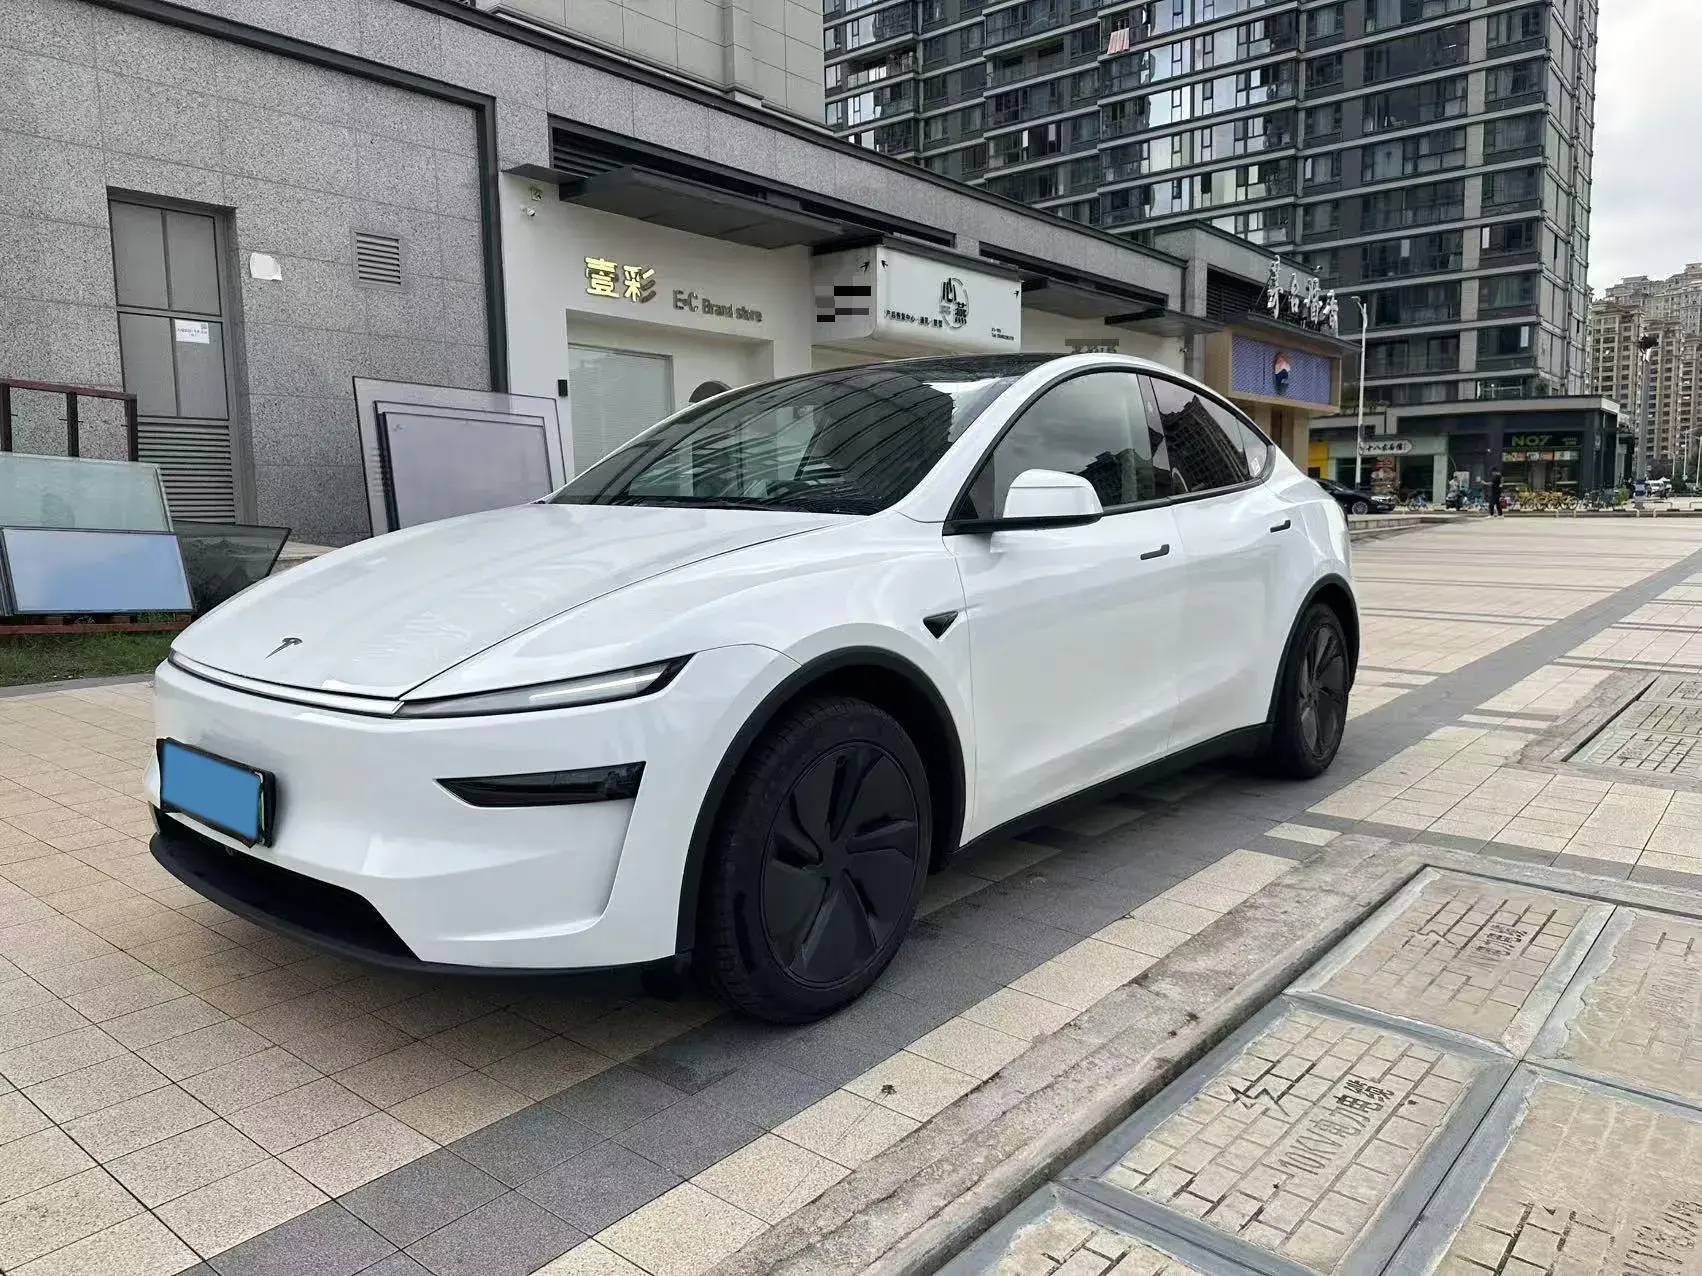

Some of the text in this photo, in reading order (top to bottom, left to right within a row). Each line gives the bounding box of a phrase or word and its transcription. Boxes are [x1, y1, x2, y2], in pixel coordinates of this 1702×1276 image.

[584, 257, 657, 303] 壹彩
[702, 298, 733, 318] Brand
[736, 306, 762, 322] store
[1278, 1079, 1395, 1175] 10KV电力电缆
